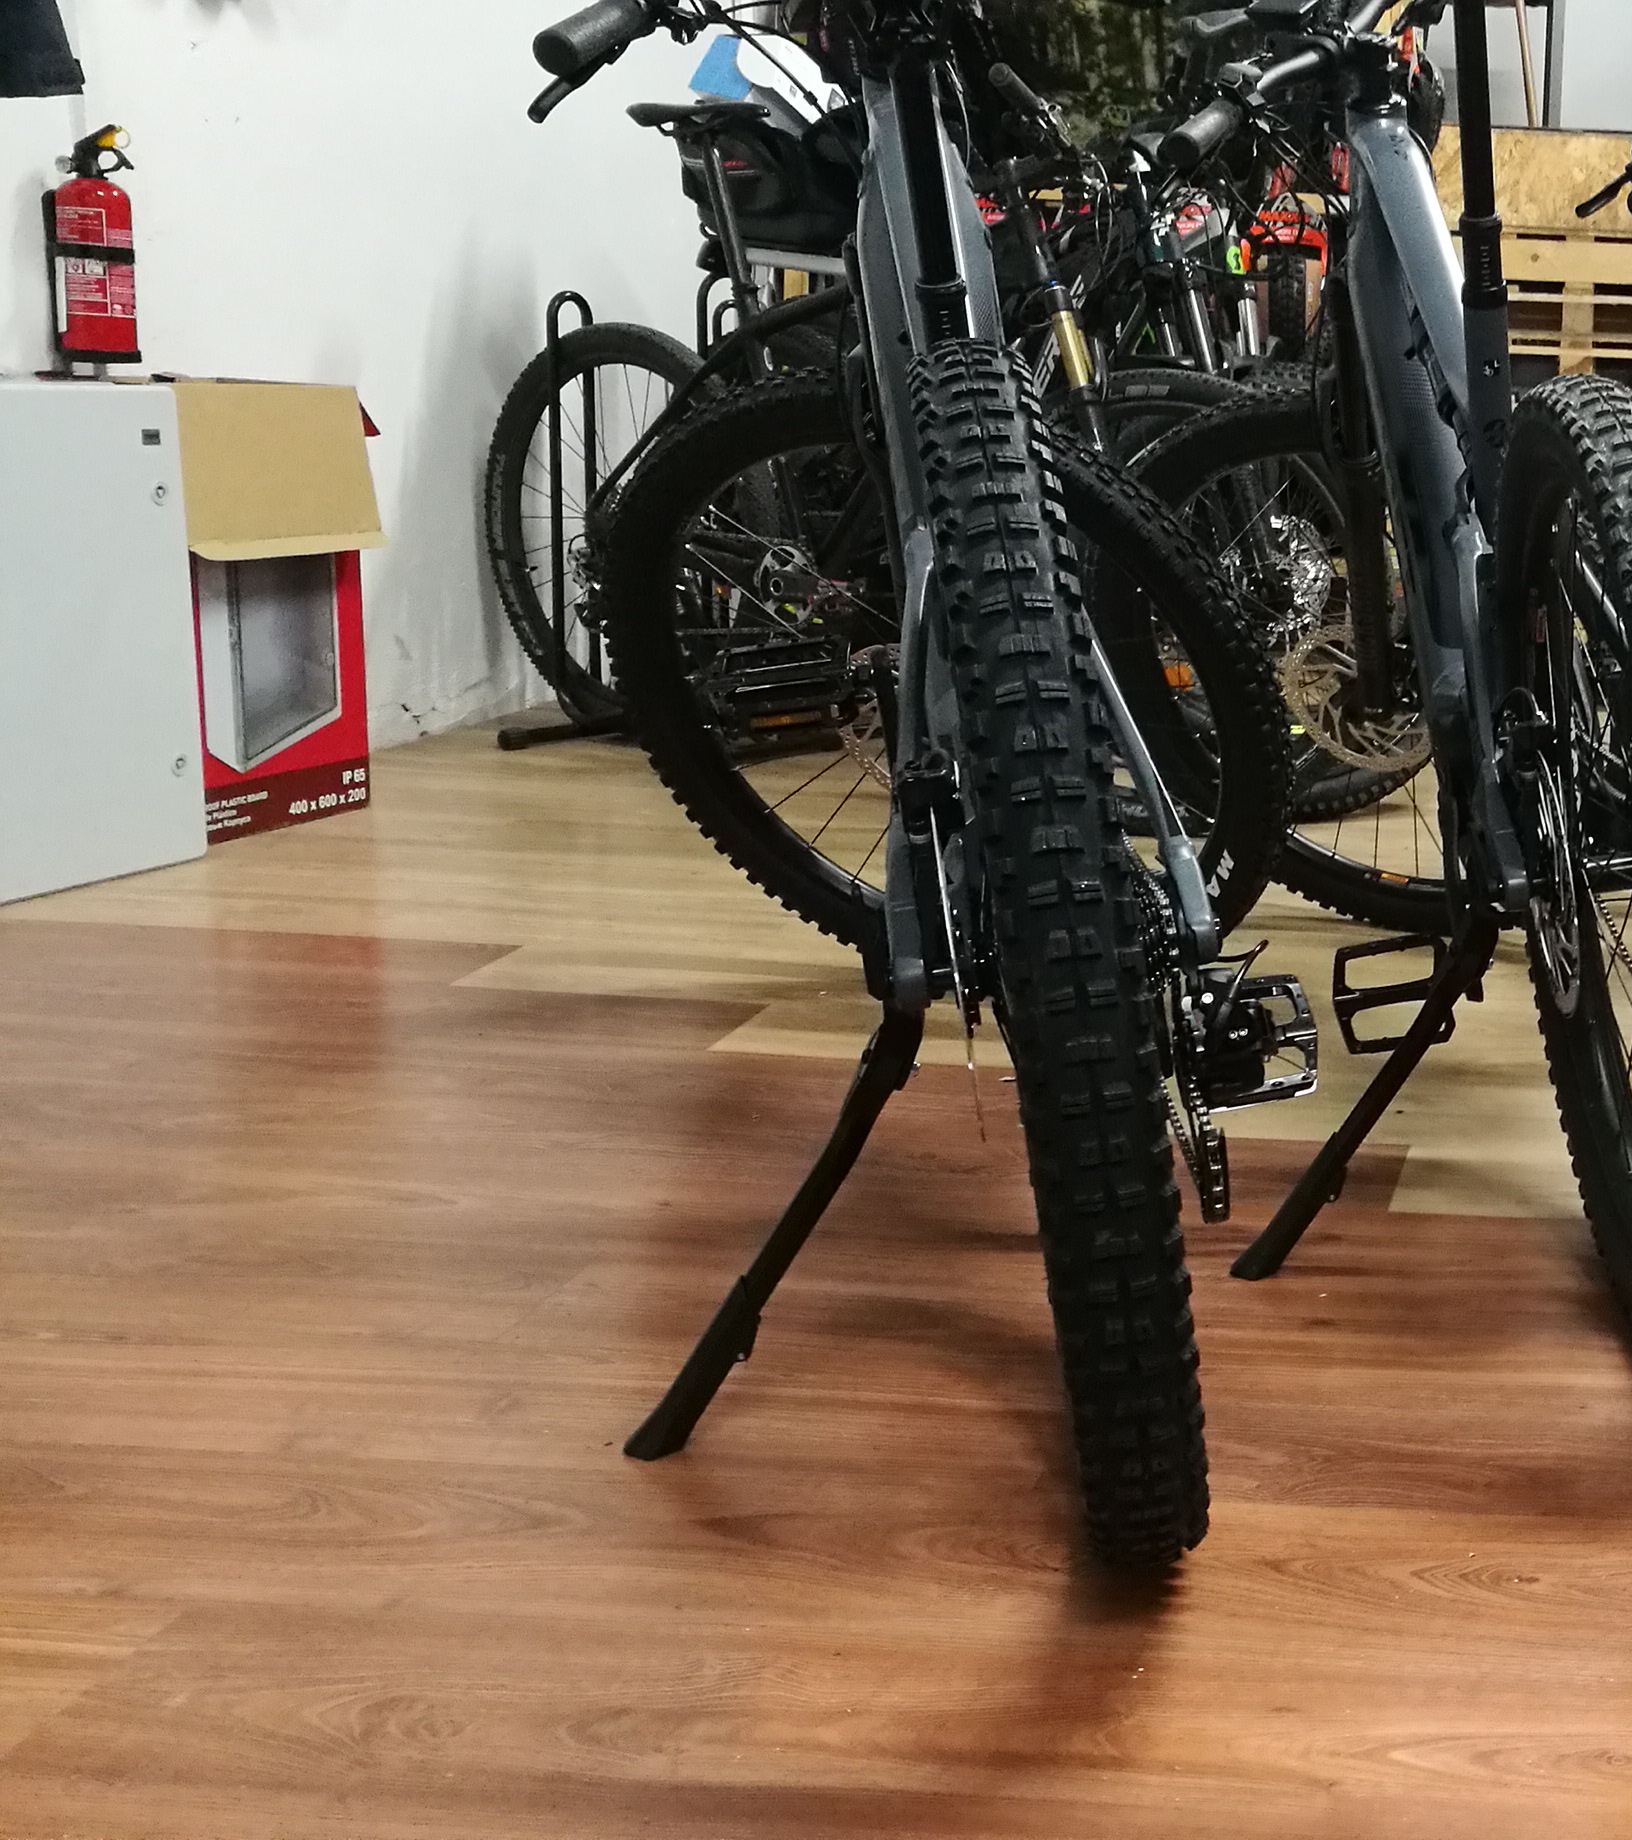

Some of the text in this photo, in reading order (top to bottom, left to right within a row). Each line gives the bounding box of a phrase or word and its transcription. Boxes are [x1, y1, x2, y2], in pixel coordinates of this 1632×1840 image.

[342, 767, 366, 785] IP 65
[288, 799, 308, 816] 400
[310, 800, 318, 812] x
[339, 793, 346, 805] x
[347, 787, 366, 803] 200
